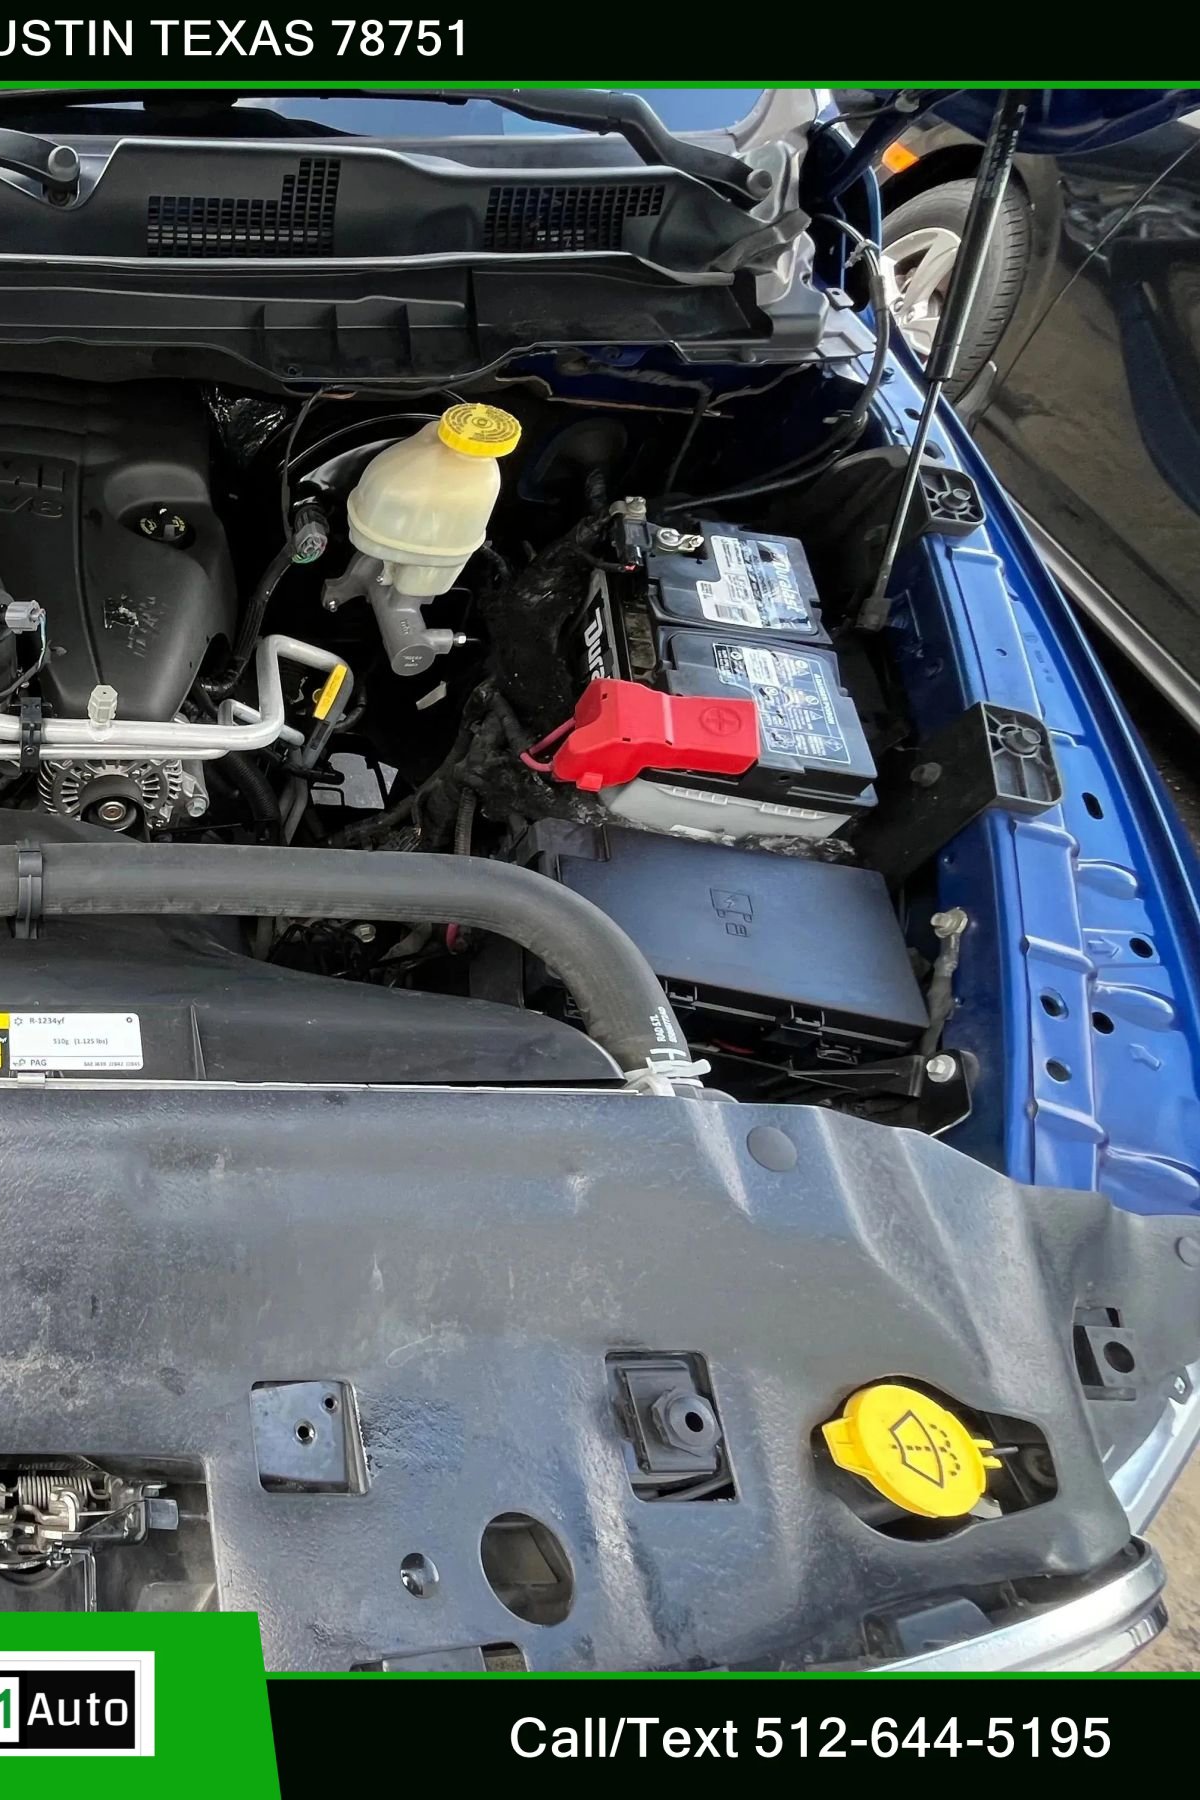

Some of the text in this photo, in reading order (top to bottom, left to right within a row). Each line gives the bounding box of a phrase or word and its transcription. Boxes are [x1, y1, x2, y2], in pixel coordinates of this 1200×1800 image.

[584, 606, 607, 681] Dura
[29, 1016, 65, 1026] R-1234yf
[30, 1058, 47, 1067] PAG
